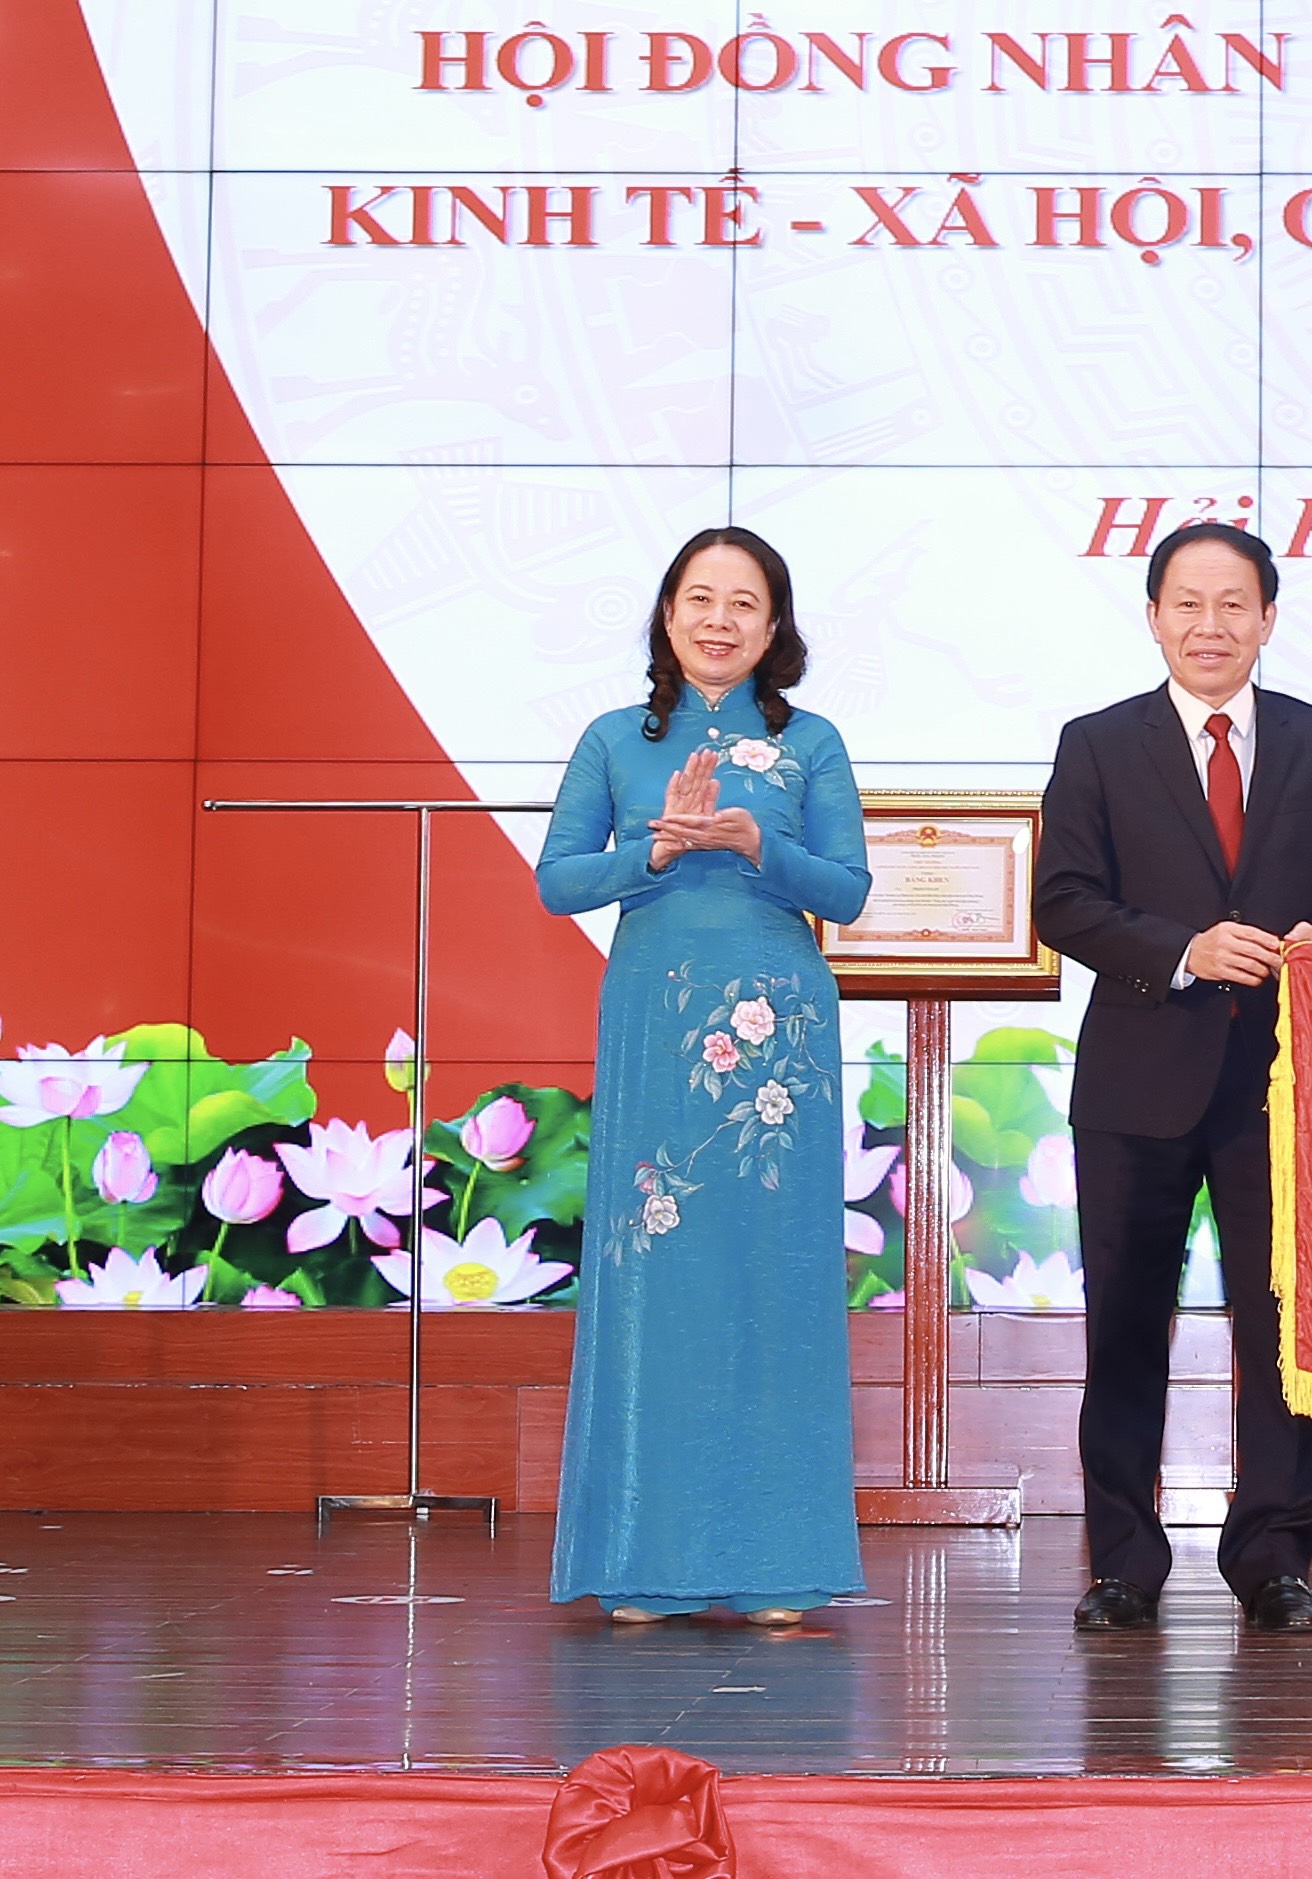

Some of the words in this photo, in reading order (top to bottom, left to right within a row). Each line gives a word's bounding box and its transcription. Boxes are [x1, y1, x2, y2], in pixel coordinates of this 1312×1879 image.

[416, 22, 611, 107] HỘI
[637, 13, 955, 91] ĐỒNG
[983, 15, 1288, 92] NHÂN
[324, 186, 597, 245] KINH
[622, 168, 763, 245] TẾ
[792, 221, 821, 231] -
[849, 173, 999, 246] XÃ
[1029, 178, 1252, 263] HỘI,
